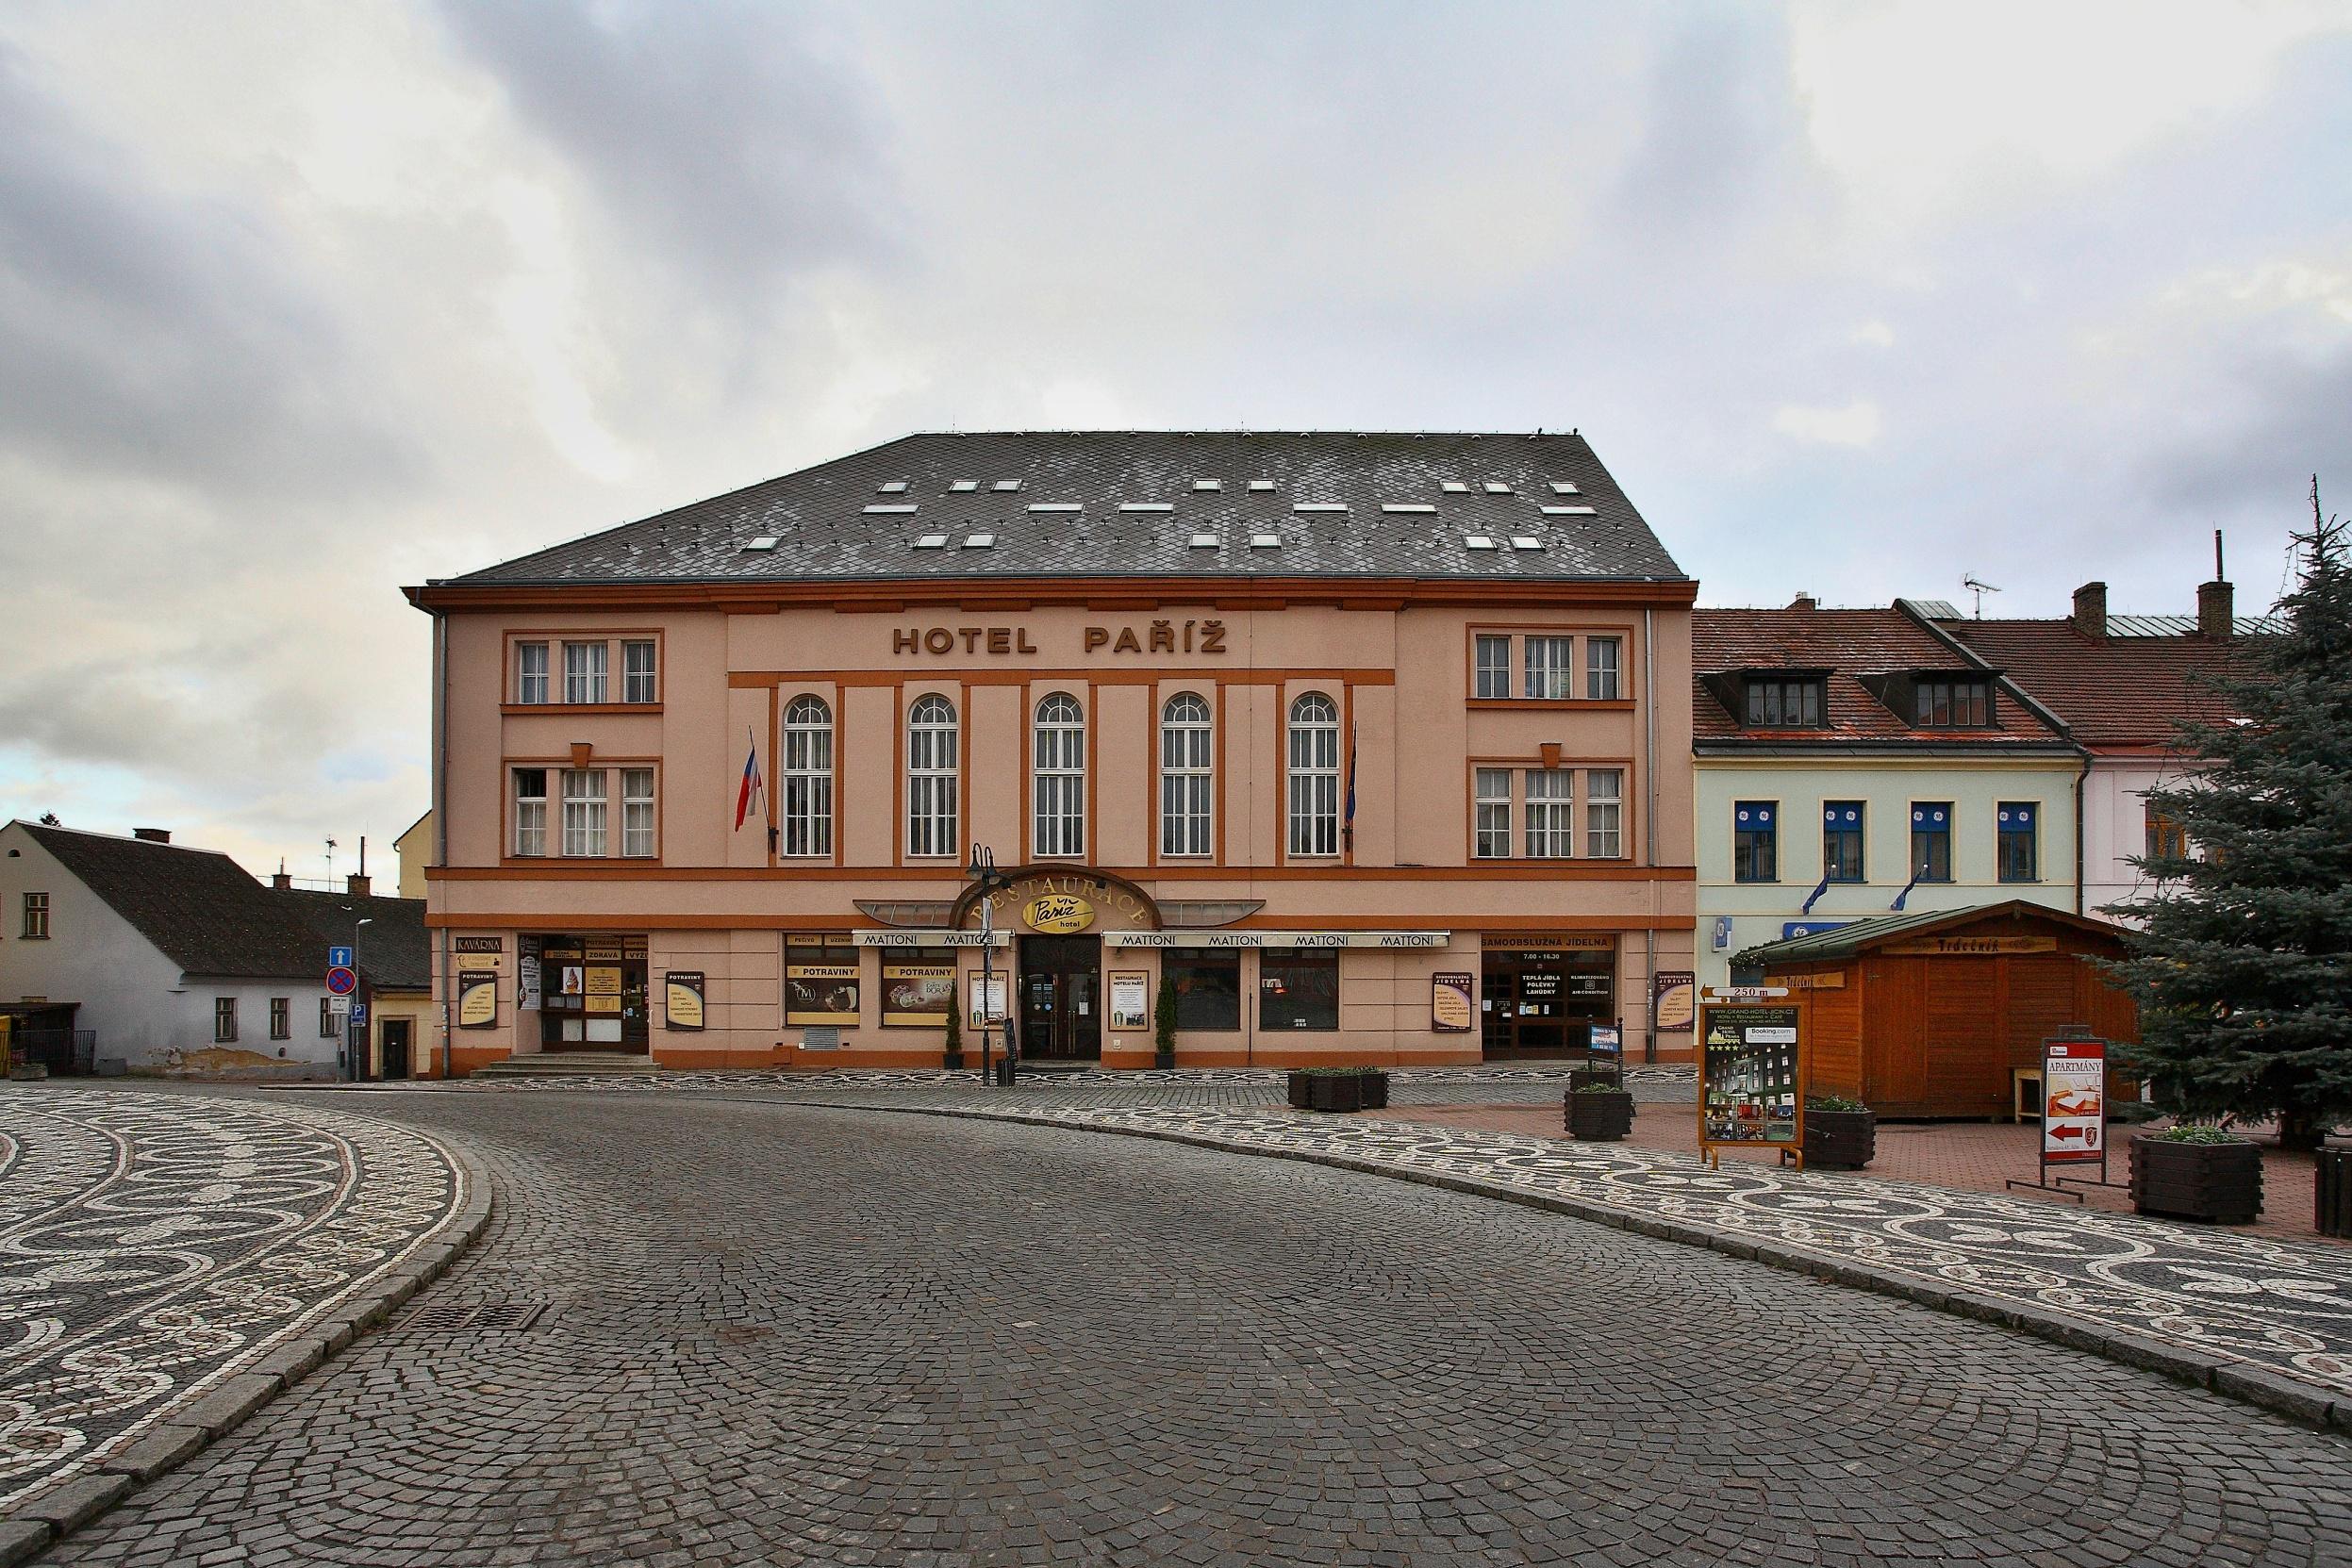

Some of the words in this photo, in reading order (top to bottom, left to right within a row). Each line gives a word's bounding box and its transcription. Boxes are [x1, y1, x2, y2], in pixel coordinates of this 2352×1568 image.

[892, 626, 1037, 654] HOTEL
[1084, 619, 1227, 653] PAŘÍŽ
[971, 876, 1148, 924] RESTAURACE
[457, 938, 500, 950] KAVÁRNA
[864, 934, 918, 945] MATTONI
[1121, 935, 1176, 946] MATTONI
[1208, 935, 1263, 946] MATTONI
[1295, 935, 1349, 946] MATTONI
[1380, 935, 1433, 946] MATTONI
[1481, 937, 1563, 947] SAMOOBSLUŽNÁ
[1565, 937, 1608, 947] JÍDELNA
[1734, 988, 1756, 997] 250
[355, 1005, 362, 1015] P
[2048, 1060, 2101, 1072] APARTMÁNY
